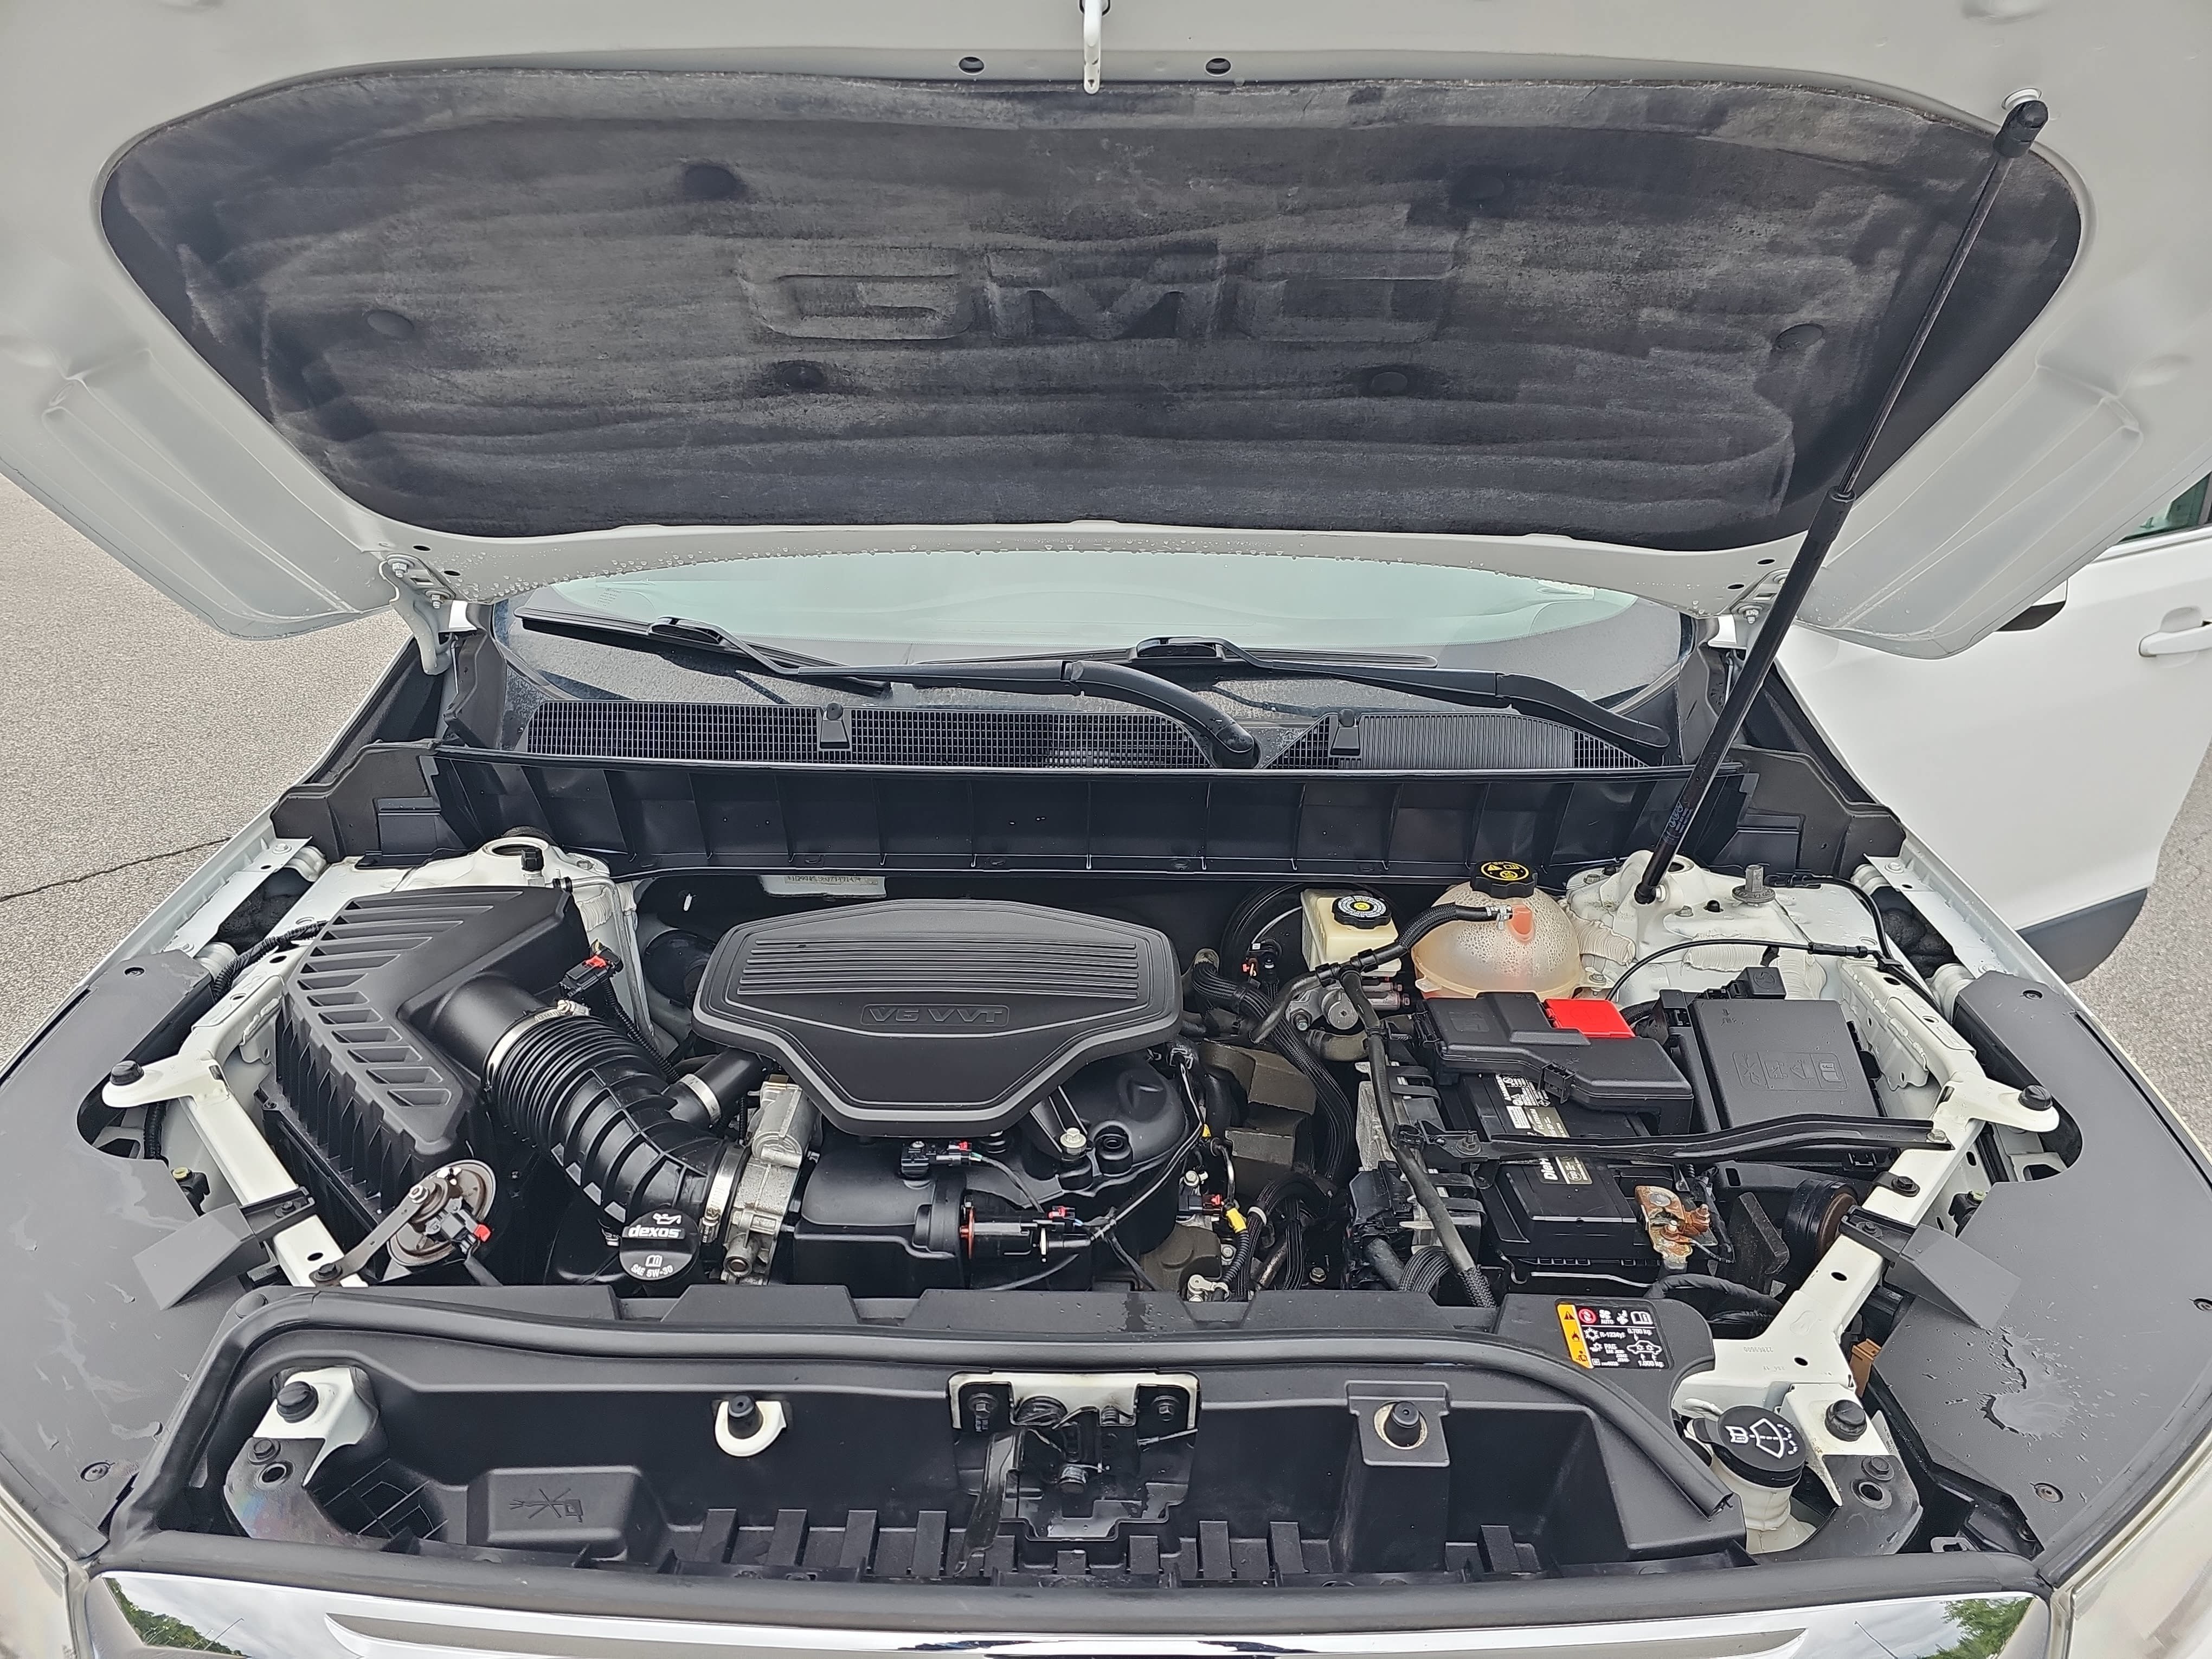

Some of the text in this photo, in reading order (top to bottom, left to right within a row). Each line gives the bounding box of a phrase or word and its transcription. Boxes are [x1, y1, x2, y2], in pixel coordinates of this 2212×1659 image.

[736, 244, 1459, 343] GMC
[869, 1008, 1003, 1023] V6 VVT
[1529, 1109, 1545, 1130] PLATINUM
[1538, 1158, 1558, 1180] DieH
[628, 1224, 681, 1238] dexos
[631, 1264, 673, 1278] SAE 5W-30
